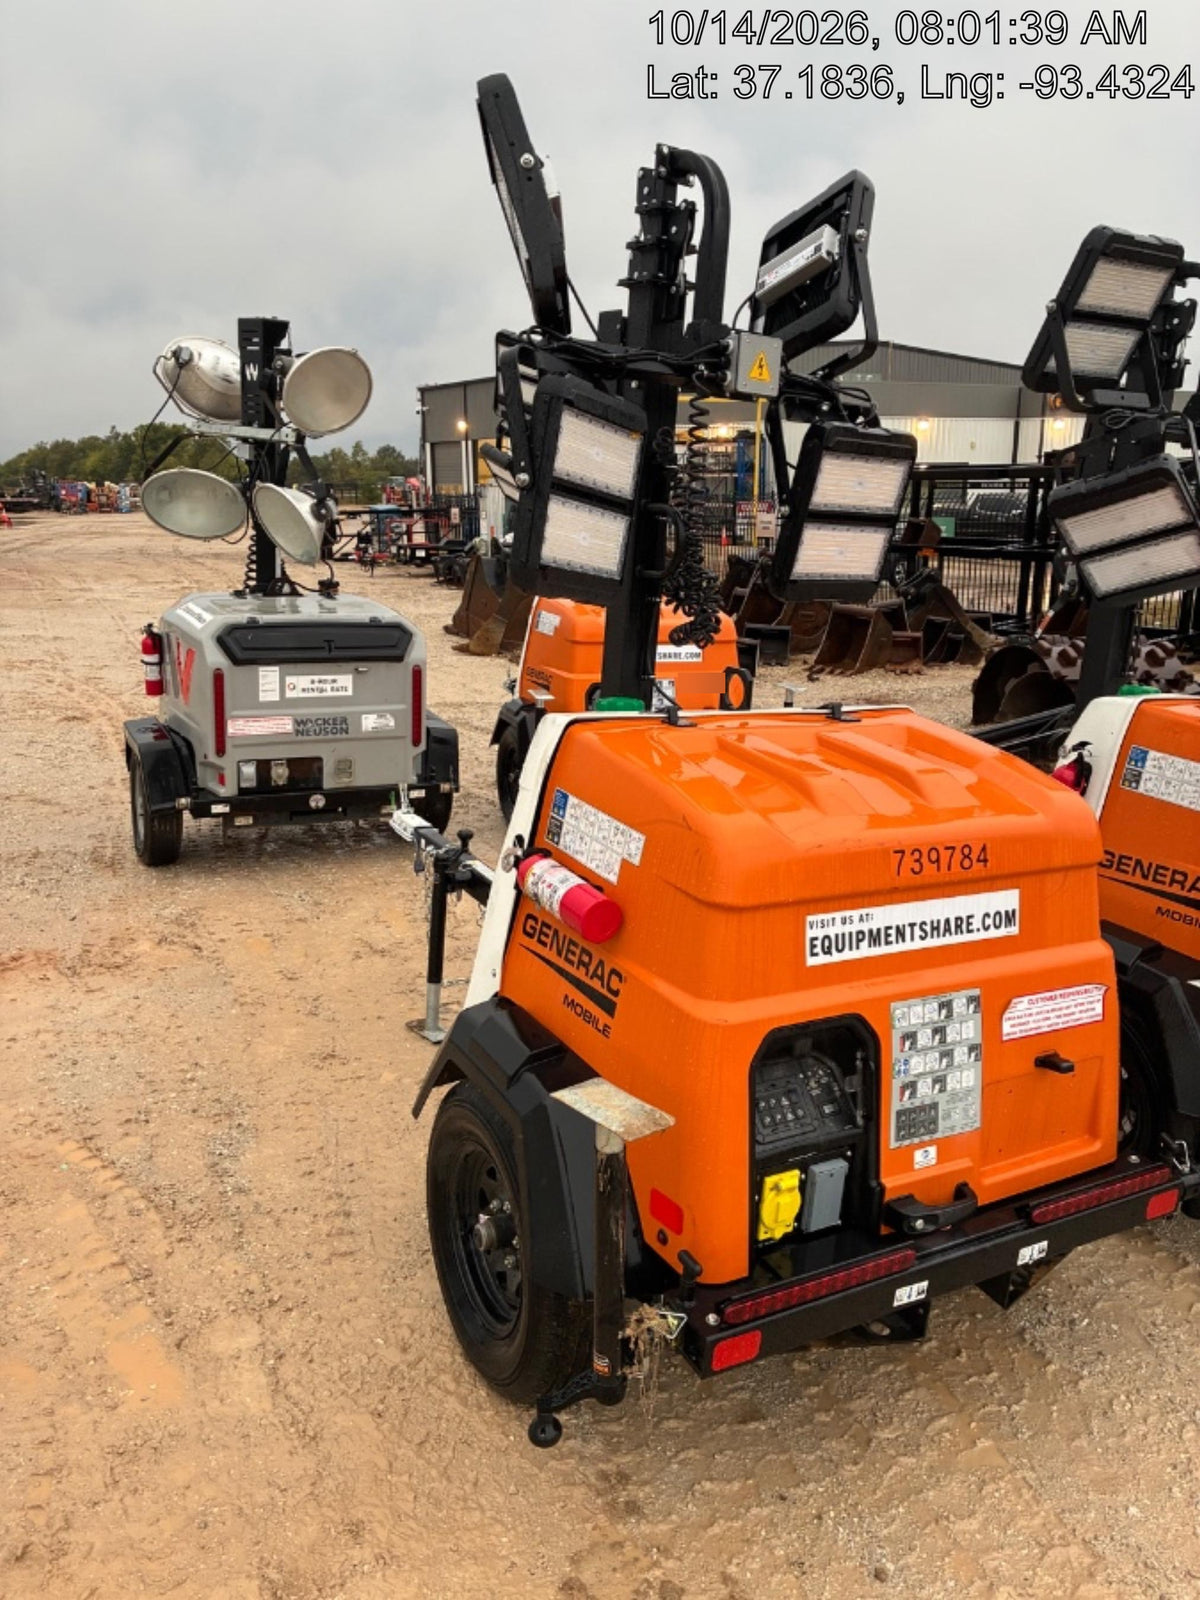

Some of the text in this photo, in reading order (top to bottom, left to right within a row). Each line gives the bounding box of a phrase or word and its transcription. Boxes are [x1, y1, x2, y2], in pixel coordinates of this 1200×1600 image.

[294, 716, 349, 728] WACKER
[294, 726, 349, 737] NEUSON
[892, 843, 990, 878] 739784
[808, 912, 875, 930] VISIT US AT:
[808, 908, 1018, 958] EQUIPMENTSHARE.COM
[521, 912, 624, 998] GENERAC
[562, 993, 612, 1039] MOBILE
